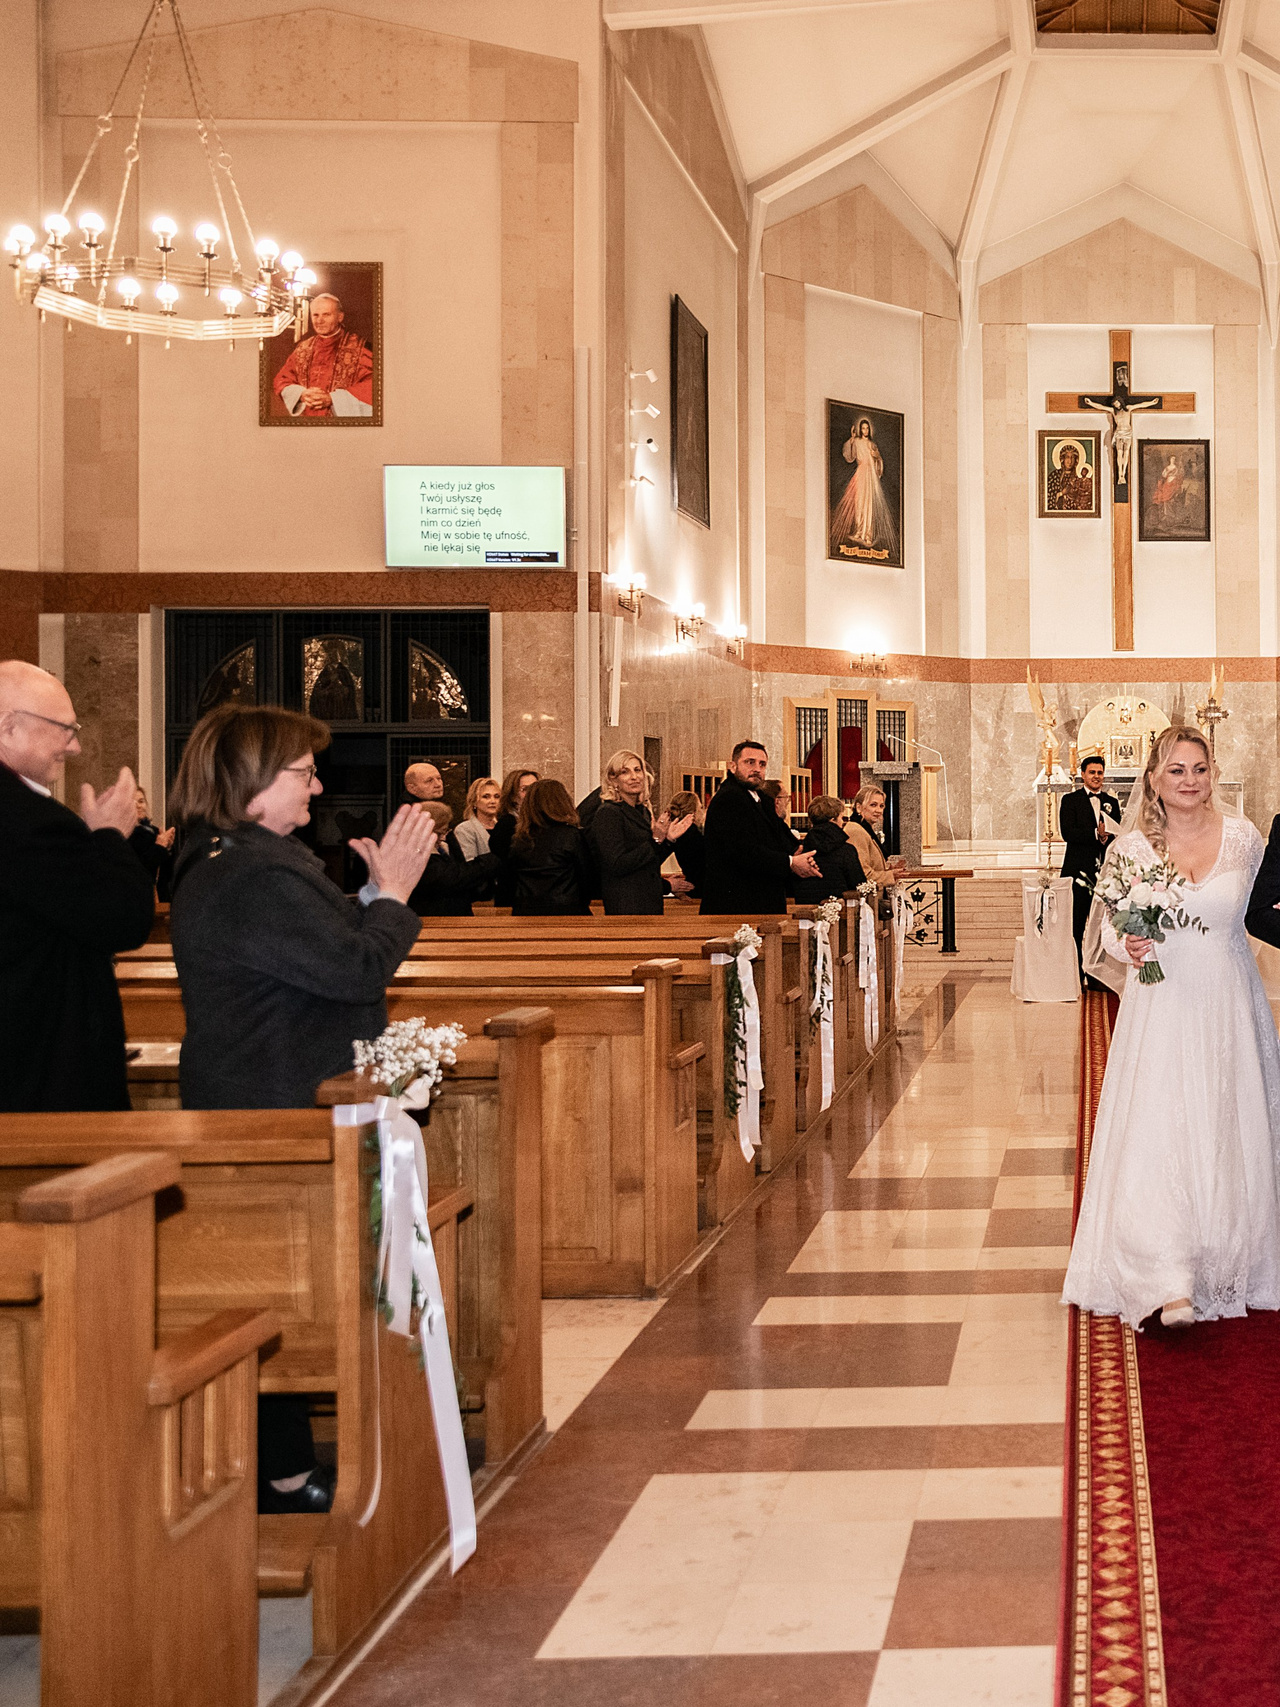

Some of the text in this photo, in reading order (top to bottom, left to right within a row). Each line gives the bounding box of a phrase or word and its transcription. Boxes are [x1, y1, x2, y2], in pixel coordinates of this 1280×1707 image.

[430, 481, 455, 492] kiedy
[458, 481, 472, 492] już
[475, 481, 496, 492] głos
[420, 494, 482, 504] Twój usłyszę
[426, 506, 459, 515] karmić
[461, 506, 475, 517] się
[478, 506, 502, 517] będę
[421, 519, 438, 527] nim
[455, 519, 481, 527] dzień
[421, 531, 441, 541] Miej
[454, 531, 480, 540] sobie
[483, 532, 492, 541] tę
[495, 531, 530, 541] ufność,
[424, 543, 481, 554] nie lękaj się
